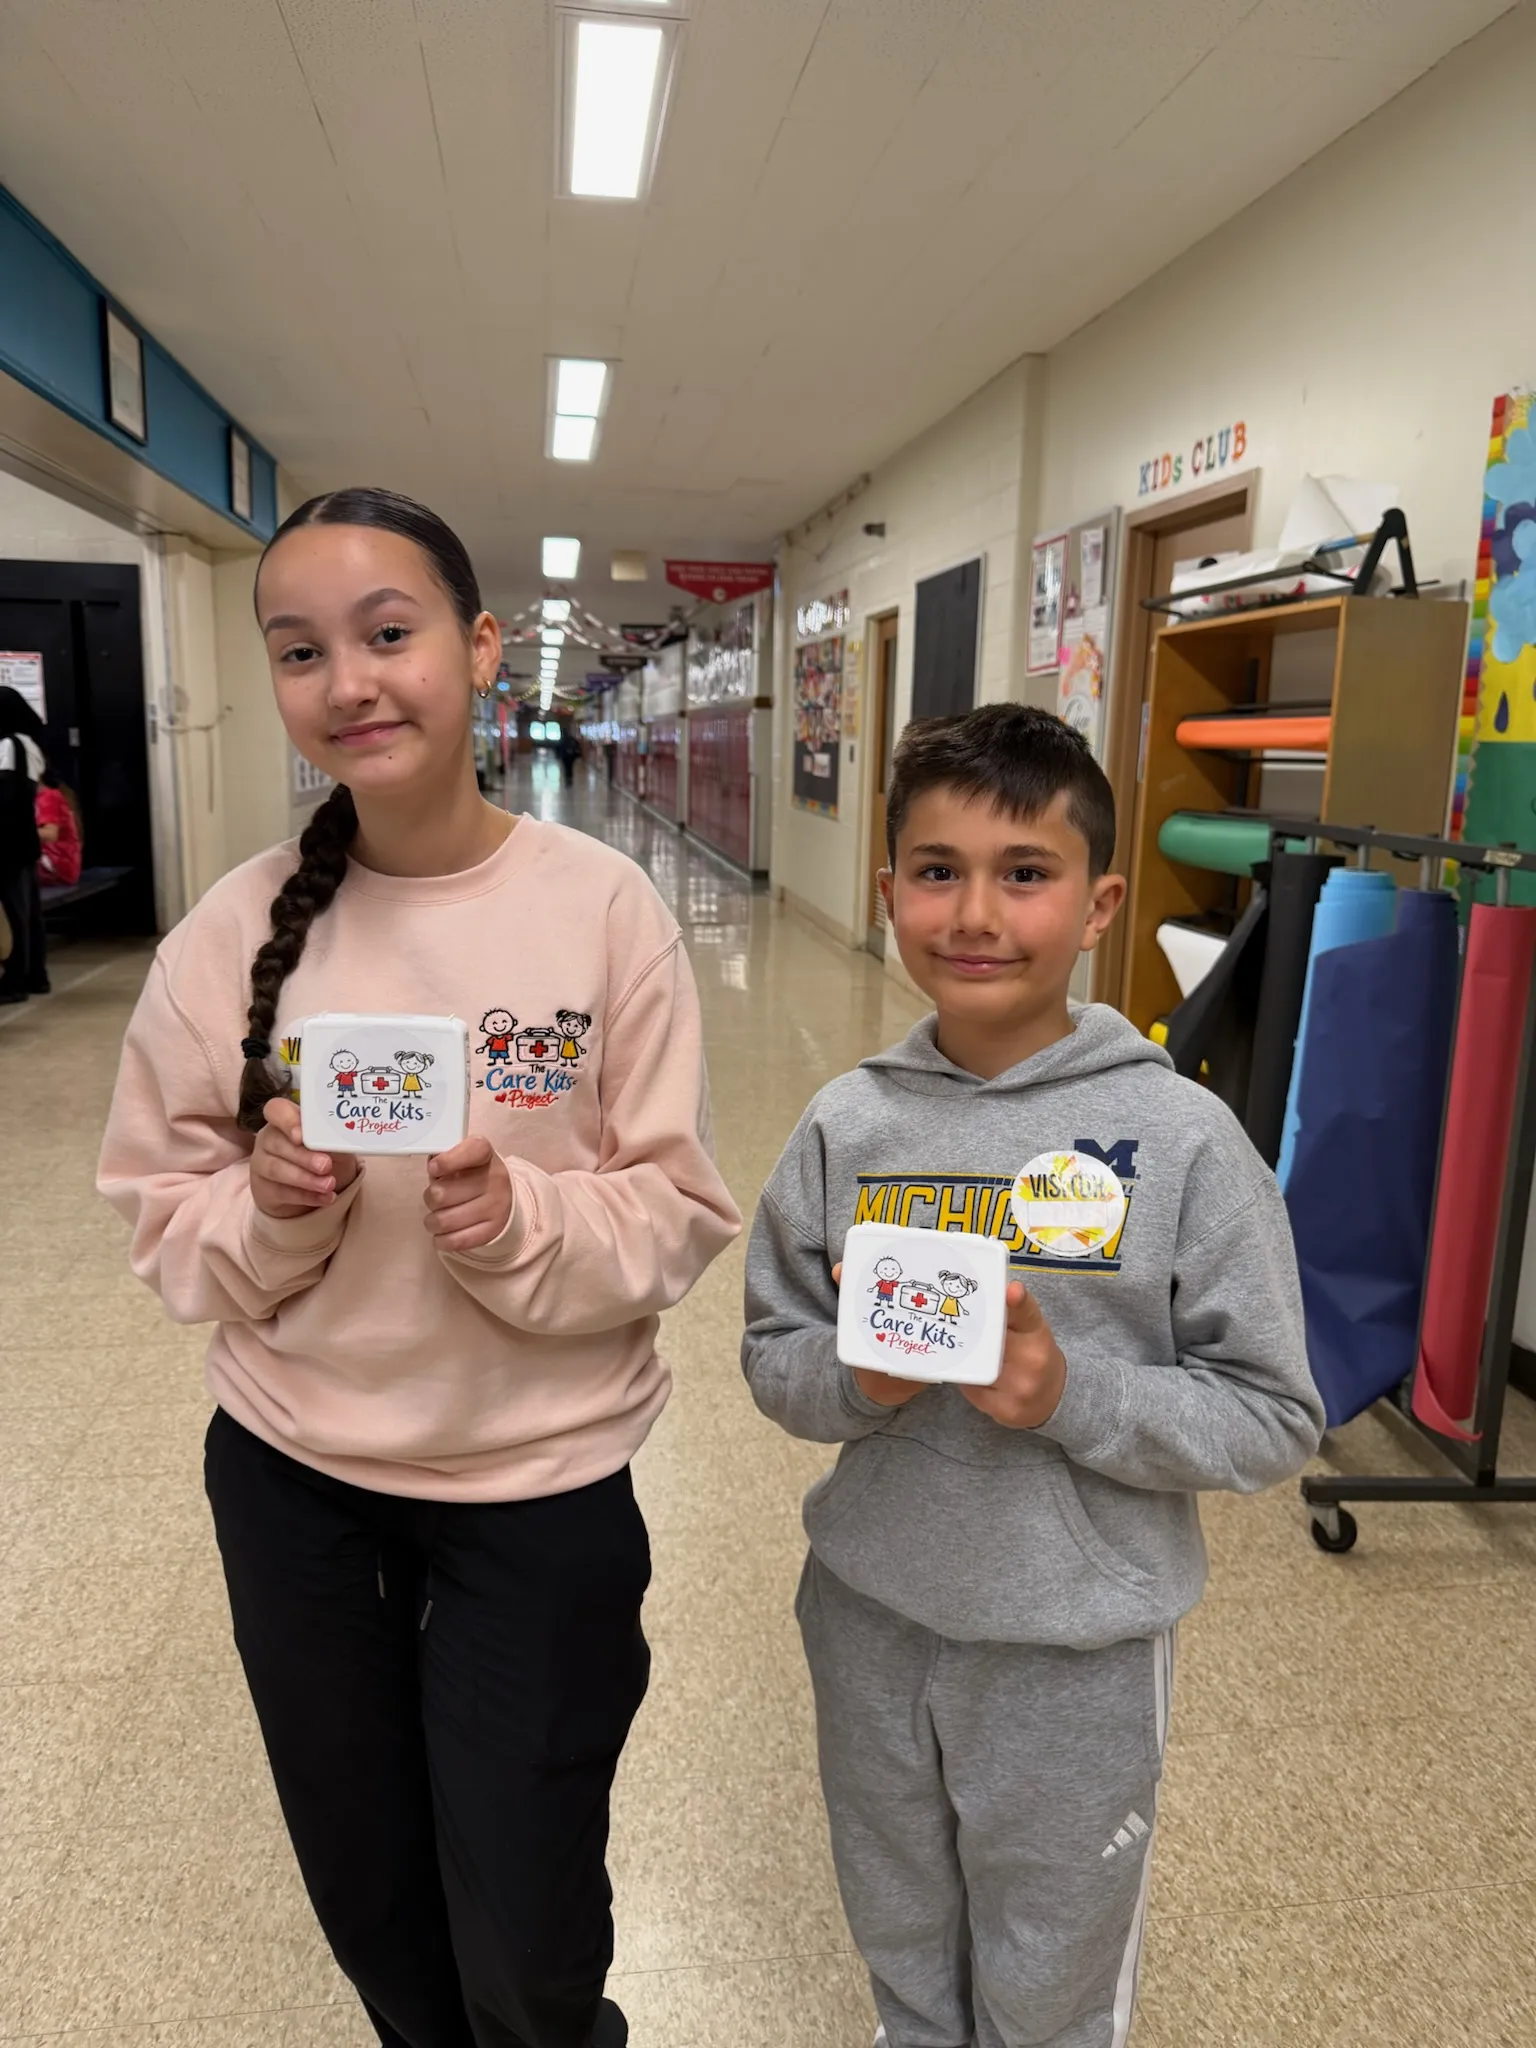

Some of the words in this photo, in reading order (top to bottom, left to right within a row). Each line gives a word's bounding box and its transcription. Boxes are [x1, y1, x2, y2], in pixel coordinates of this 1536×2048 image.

[1191, 420, 1247, 476] CLUB
[529, 1064, 546, 1073] The
[486, 1068, 538, 1091] Care
[544, 1069, 574, 1092] Kits
[373, 1096, 388, 1104] The
[508, 1089, 559, 1110] Project
[336, 1100, 382, 1119] Care
[389, 1101, 425, 1120] Kits
[357, 1118, 408, 1135] Project
[908, 1312, 923, 1323] The
[870, 1309, 915, 1336] Care
[921, 1321, 956, 1349] Kits
[886, 1332, 937, 1355] Project
